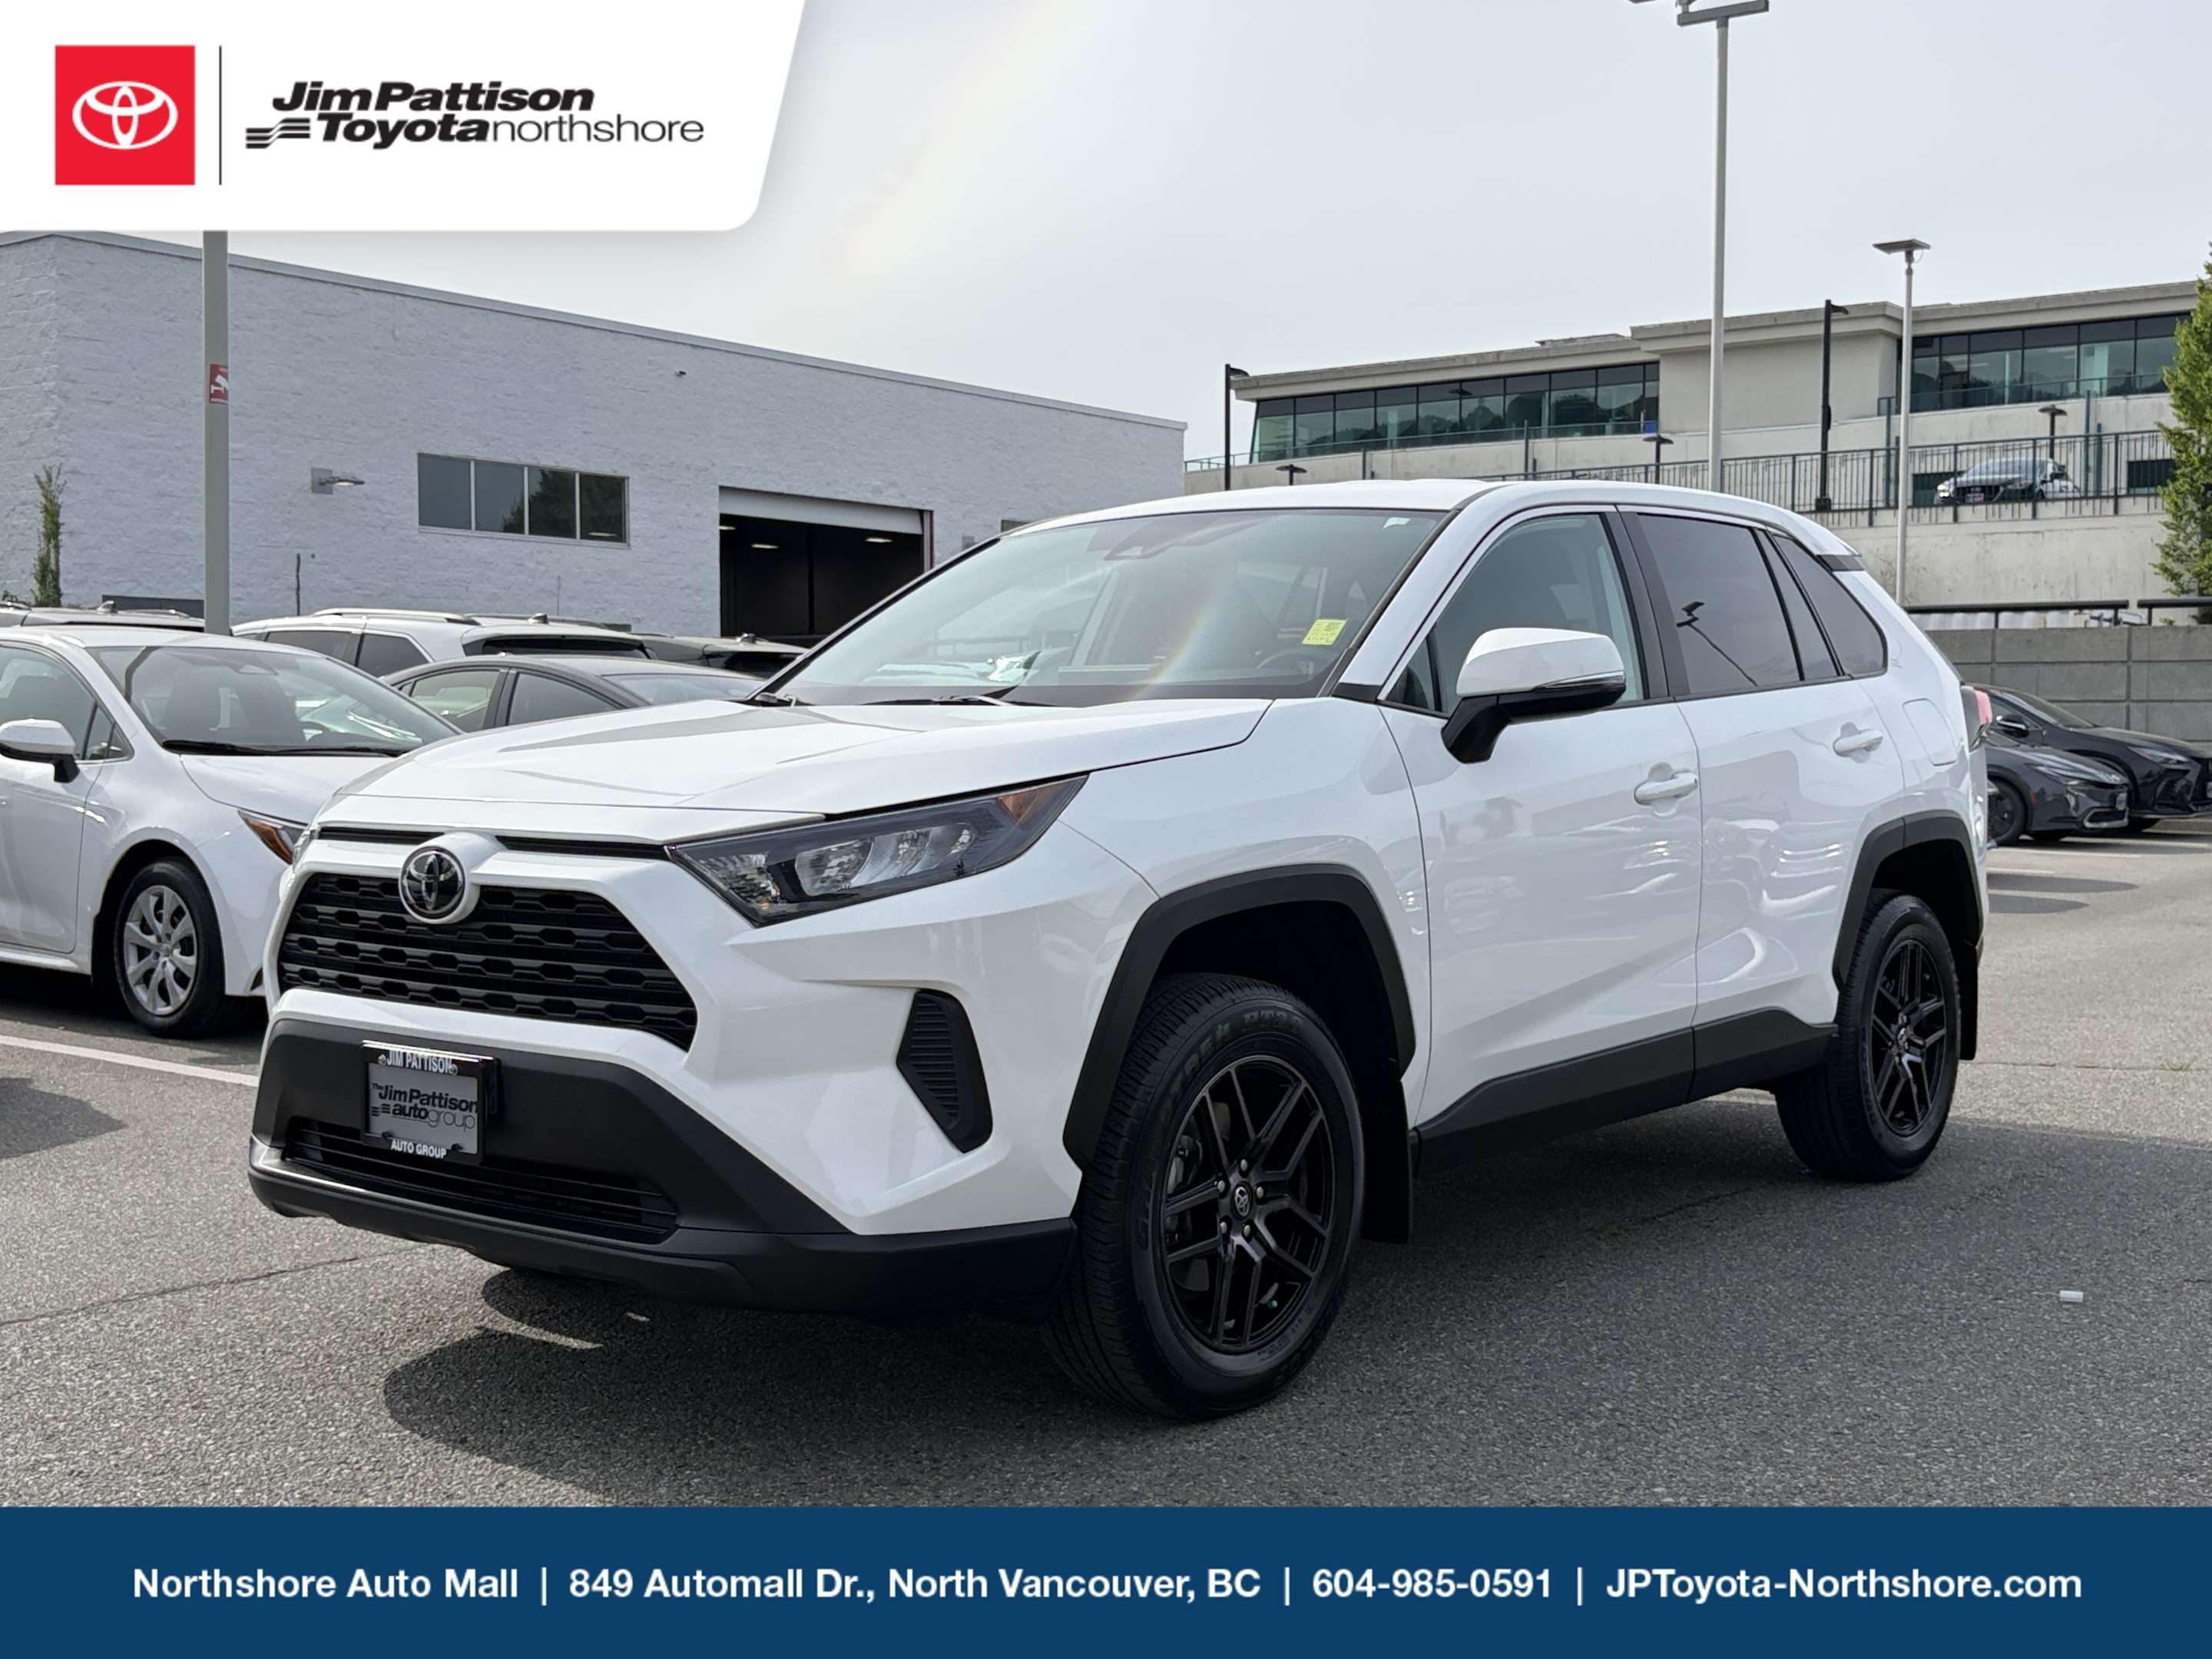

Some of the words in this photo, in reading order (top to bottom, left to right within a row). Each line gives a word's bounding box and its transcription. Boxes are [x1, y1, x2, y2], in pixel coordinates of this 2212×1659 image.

[386, 1048, 404, 1067] JIM
[405, 1051, 453, 1074] PATTISON
[379, 1084, 407, 1103] Jim
[390, 1138, 415, 1154] AUTO
[416, 1143, 447, 1159] GROUP
